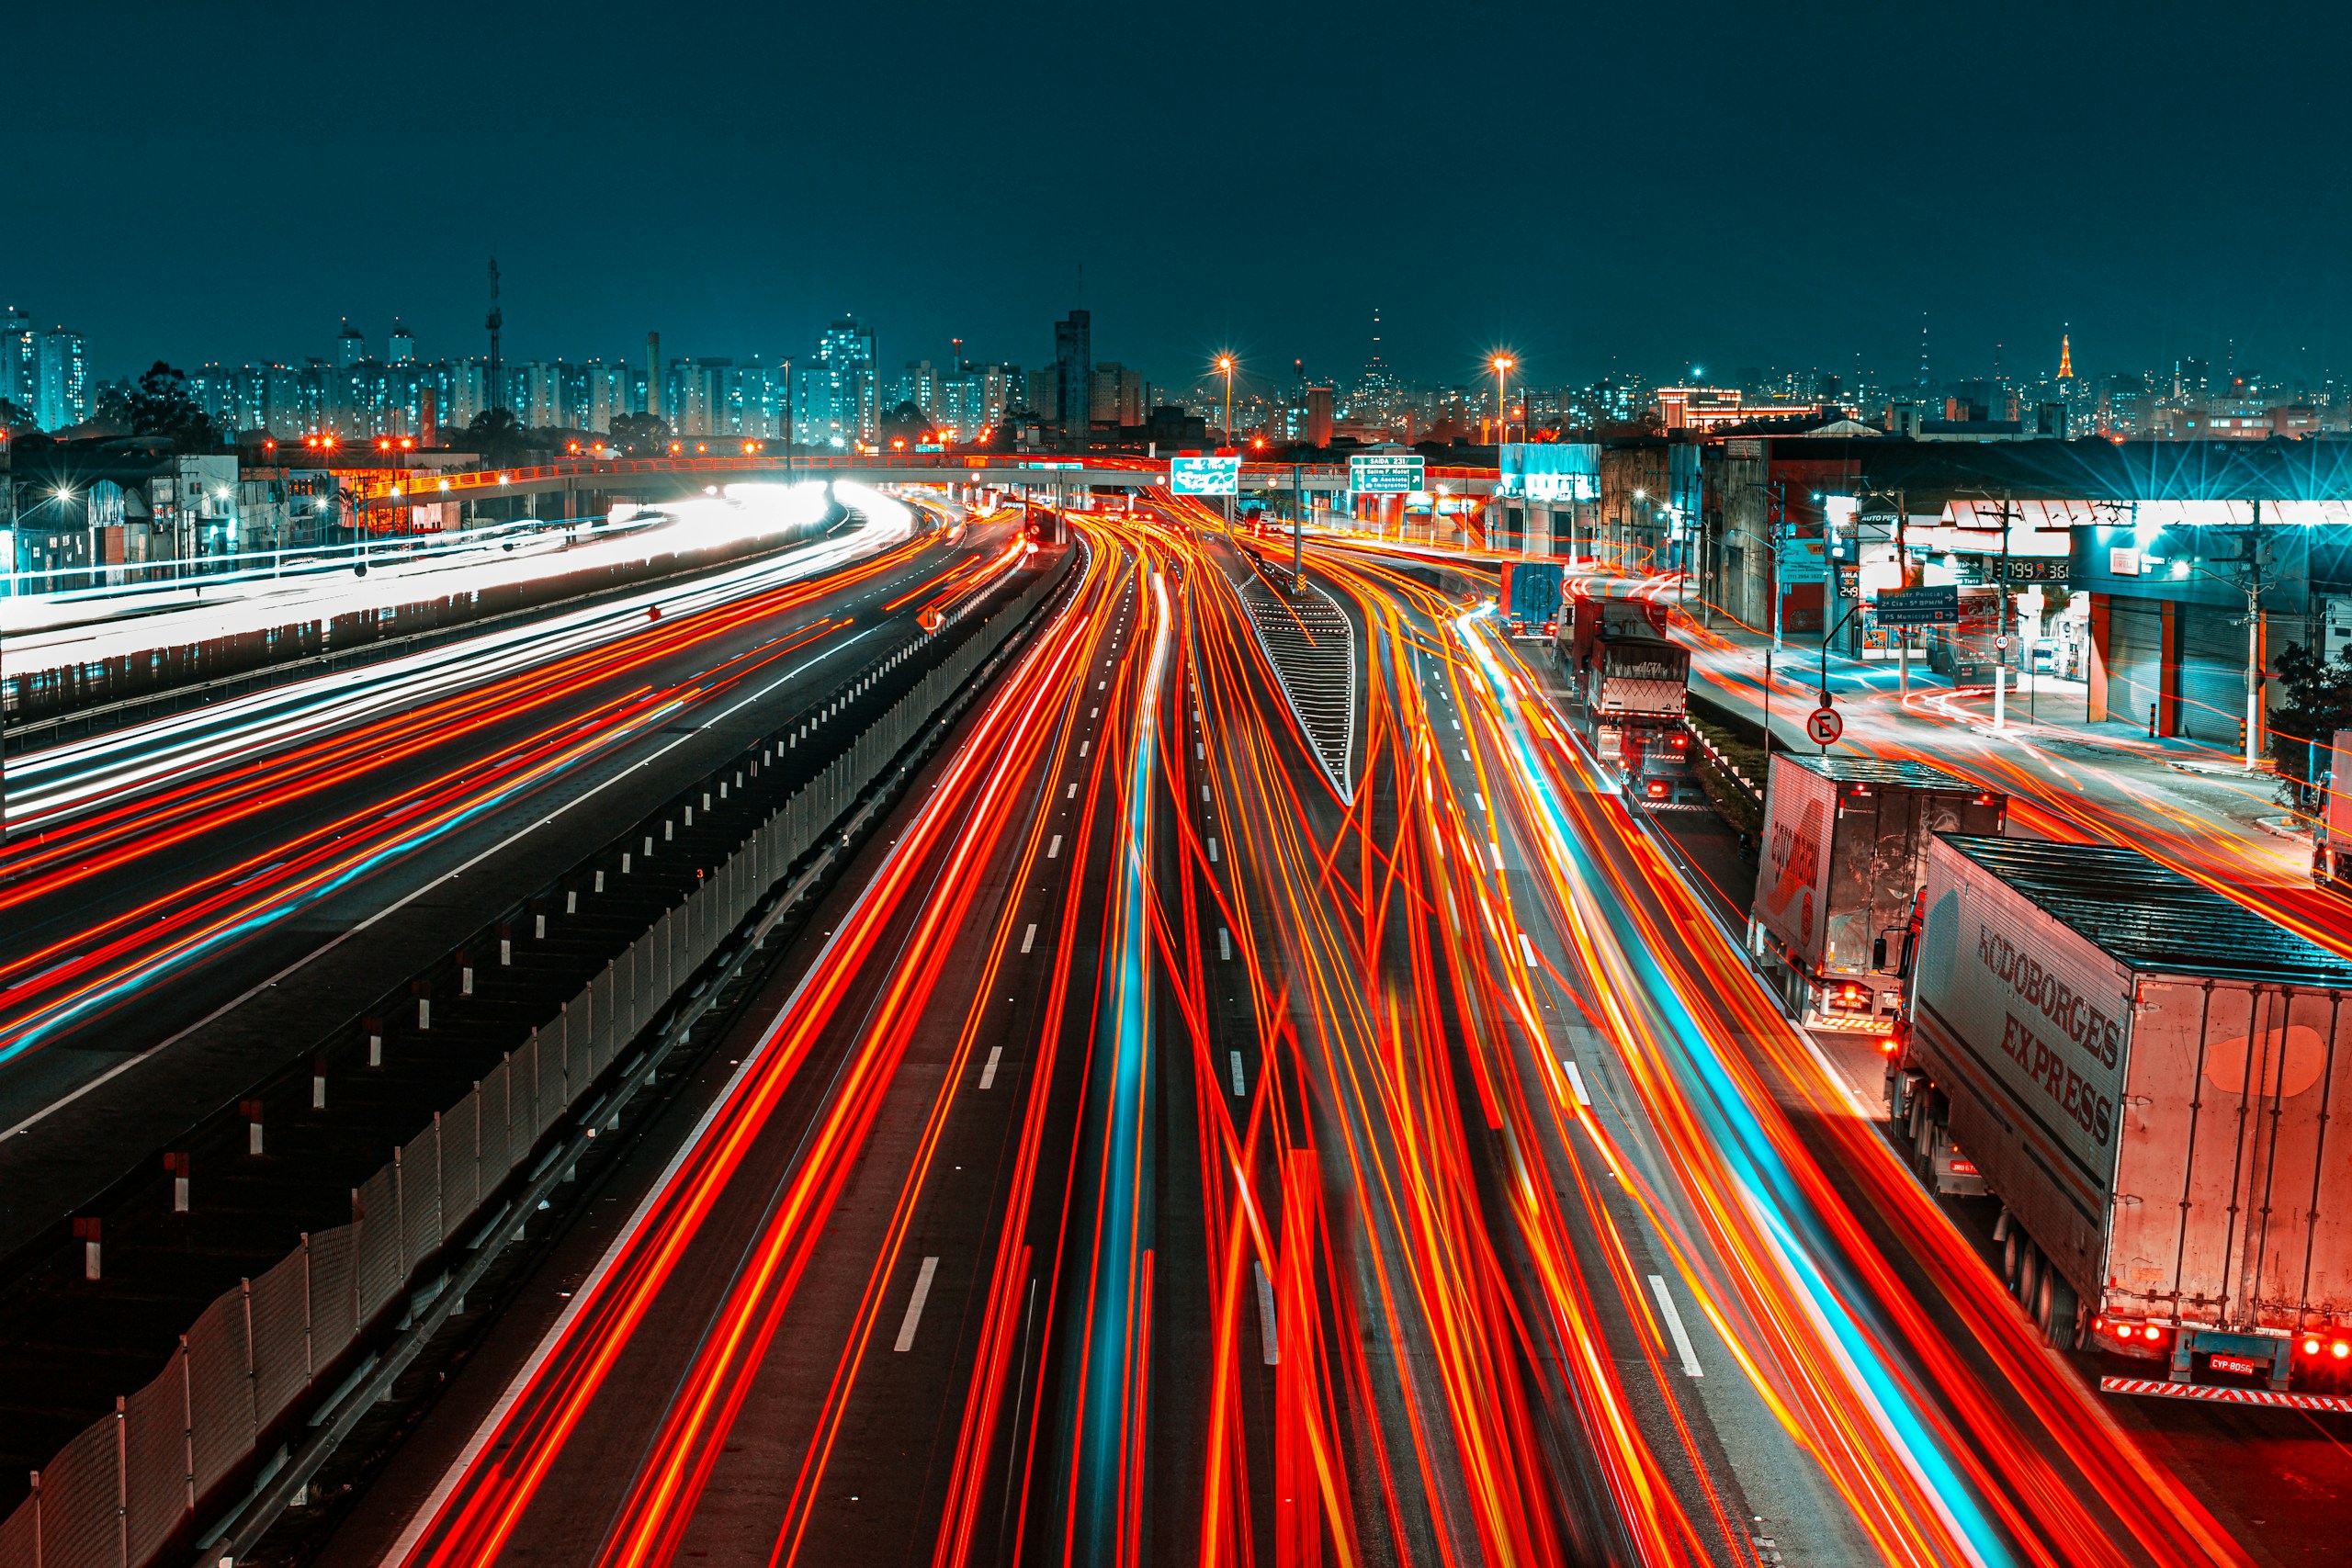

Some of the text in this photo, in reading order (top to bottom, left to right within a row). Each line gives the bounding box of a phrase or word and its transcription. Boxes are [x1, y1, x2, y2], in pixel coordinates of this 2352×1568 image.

[1782, 583, 1792, 595] 41
[1818, 716, 1831, 738] E
[2001, 1011, 2111, 1146] EXPRESS
